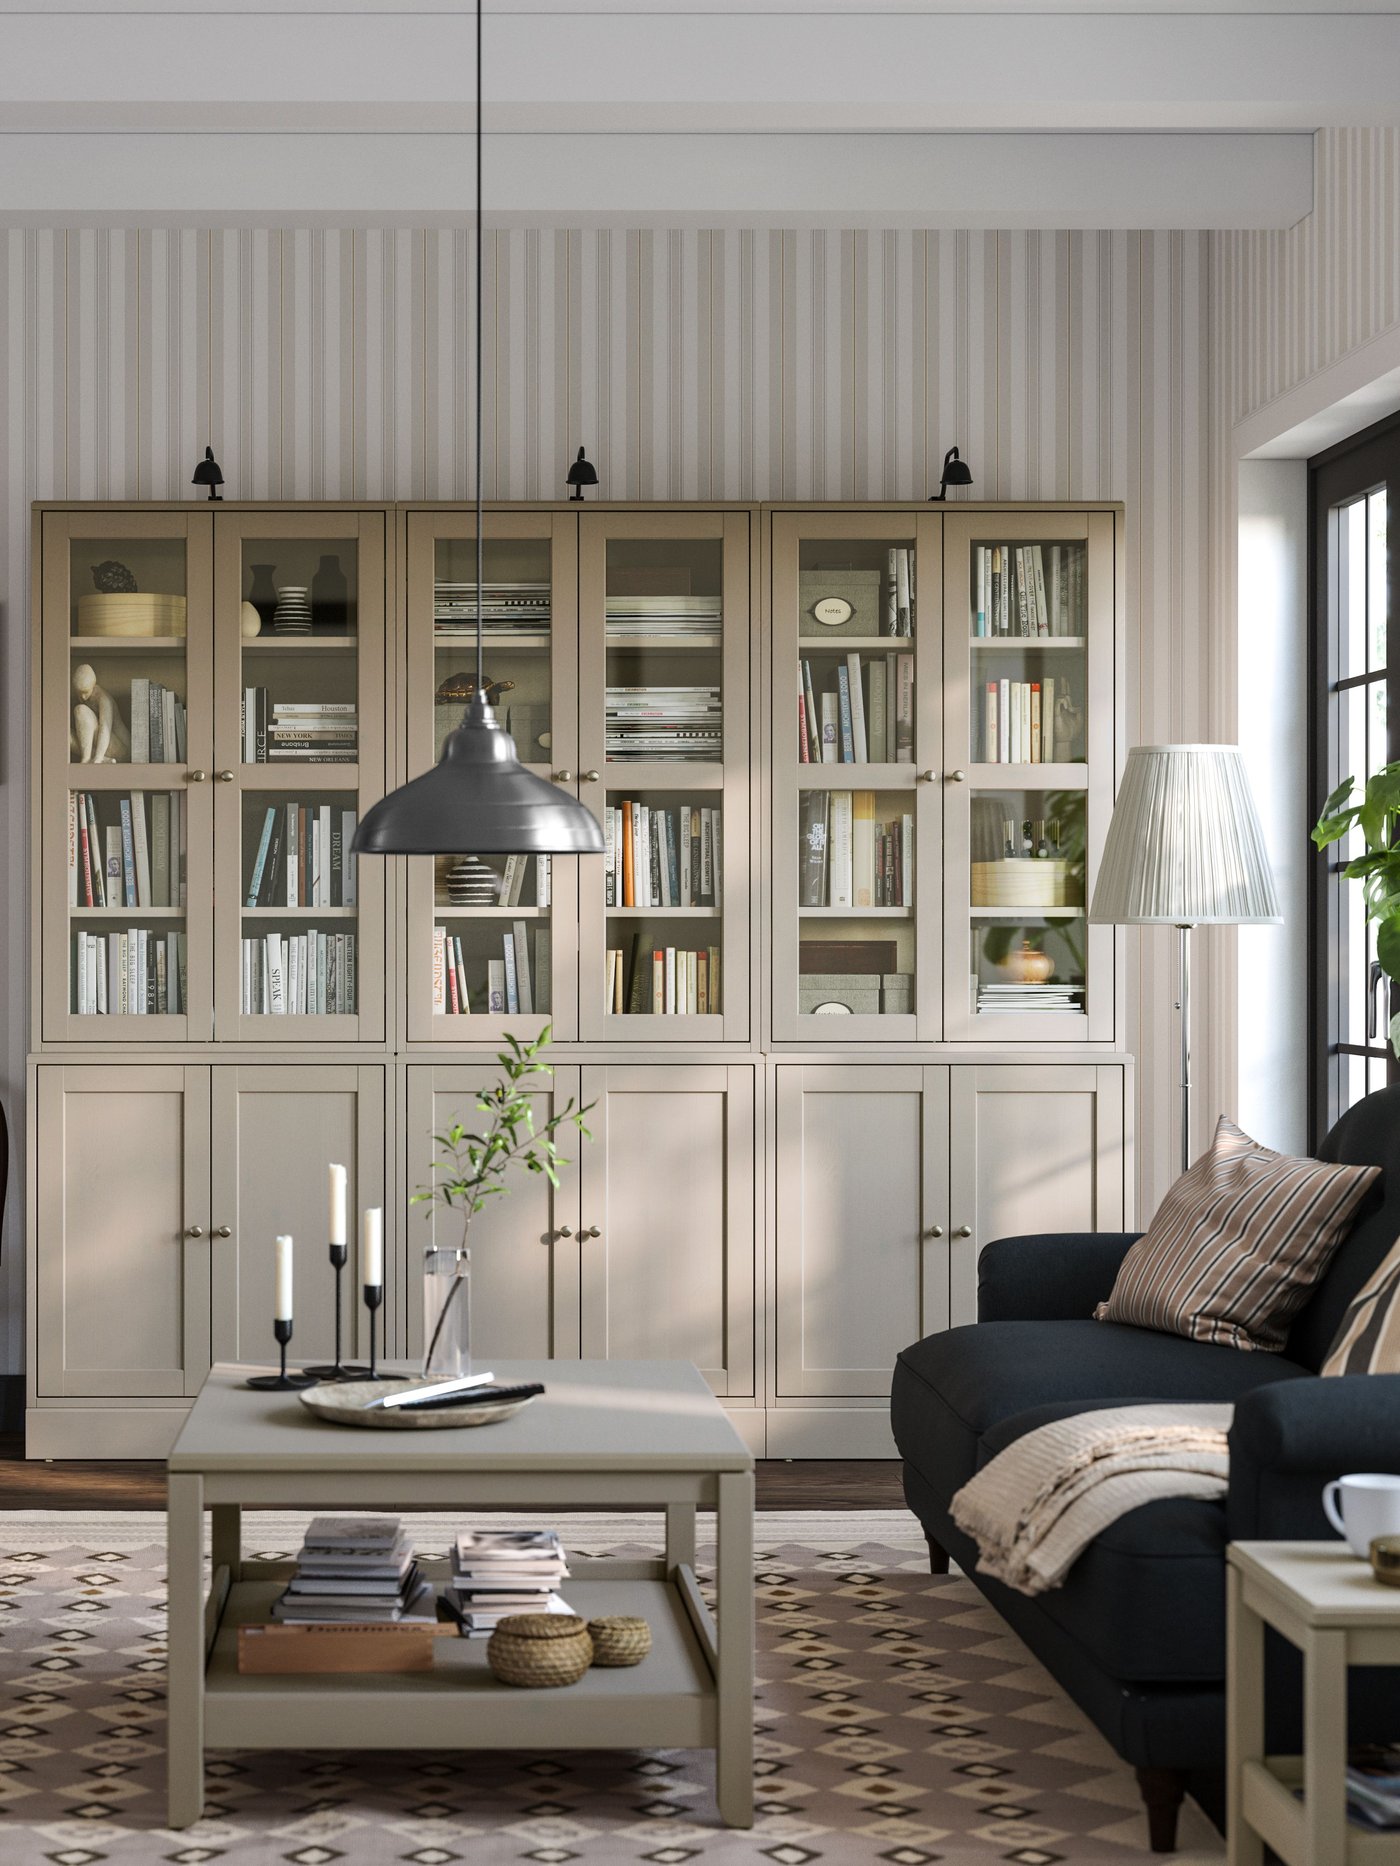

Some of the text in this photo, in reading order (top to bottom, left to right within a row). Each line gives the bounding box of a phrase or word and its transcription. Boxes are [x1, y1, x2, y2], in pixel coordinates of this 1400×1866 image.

[840, 676, 848, 693] 2000
[844, 732, 853, 752] BERLIN
[122, 808, 130, 826] 2000
[332, 832, 341, 870] DREAM
[126, 866, 135, 886] BERLIN
[505, 944, 513, 960] 2000
[272, 968, 282, 1000] SPEAK
